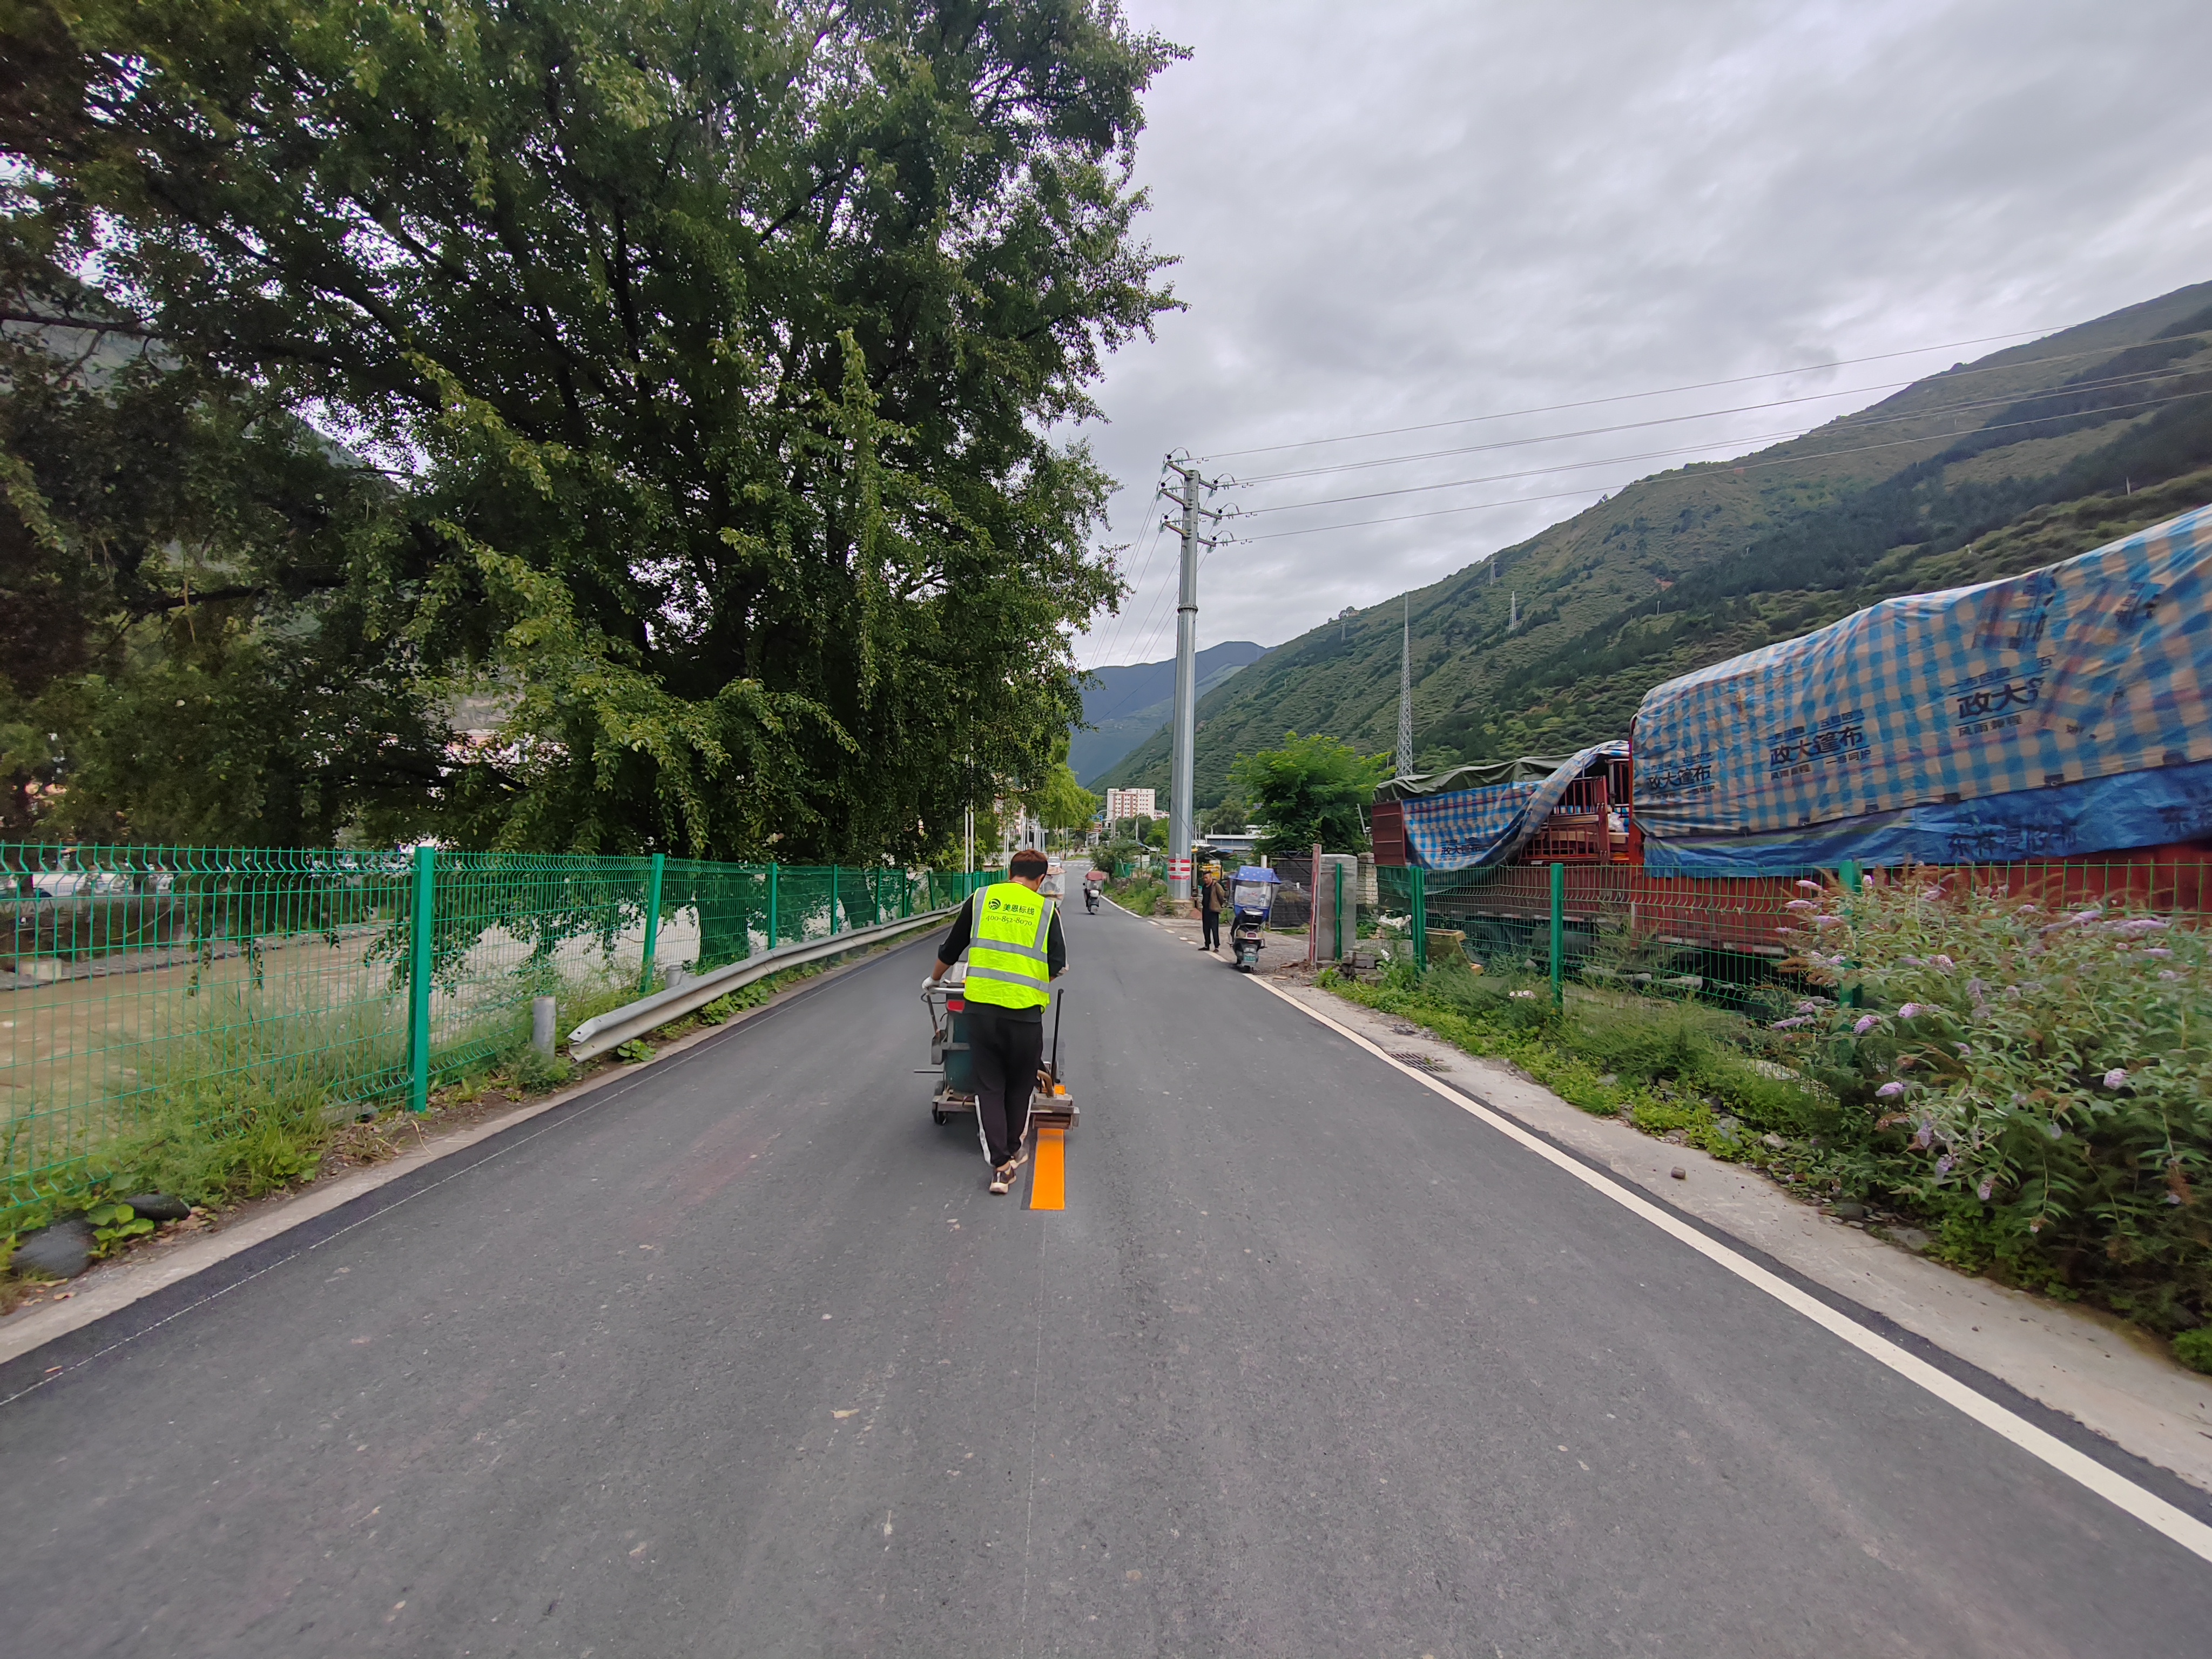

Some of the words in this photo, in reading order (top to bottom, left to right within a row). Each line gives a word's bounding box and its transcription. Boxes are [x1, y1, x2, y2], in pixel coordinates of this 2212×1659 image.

[1002, 903, 1035, 915] 美恩标线
[985, 915, 1033, 927] 400-852-8070
